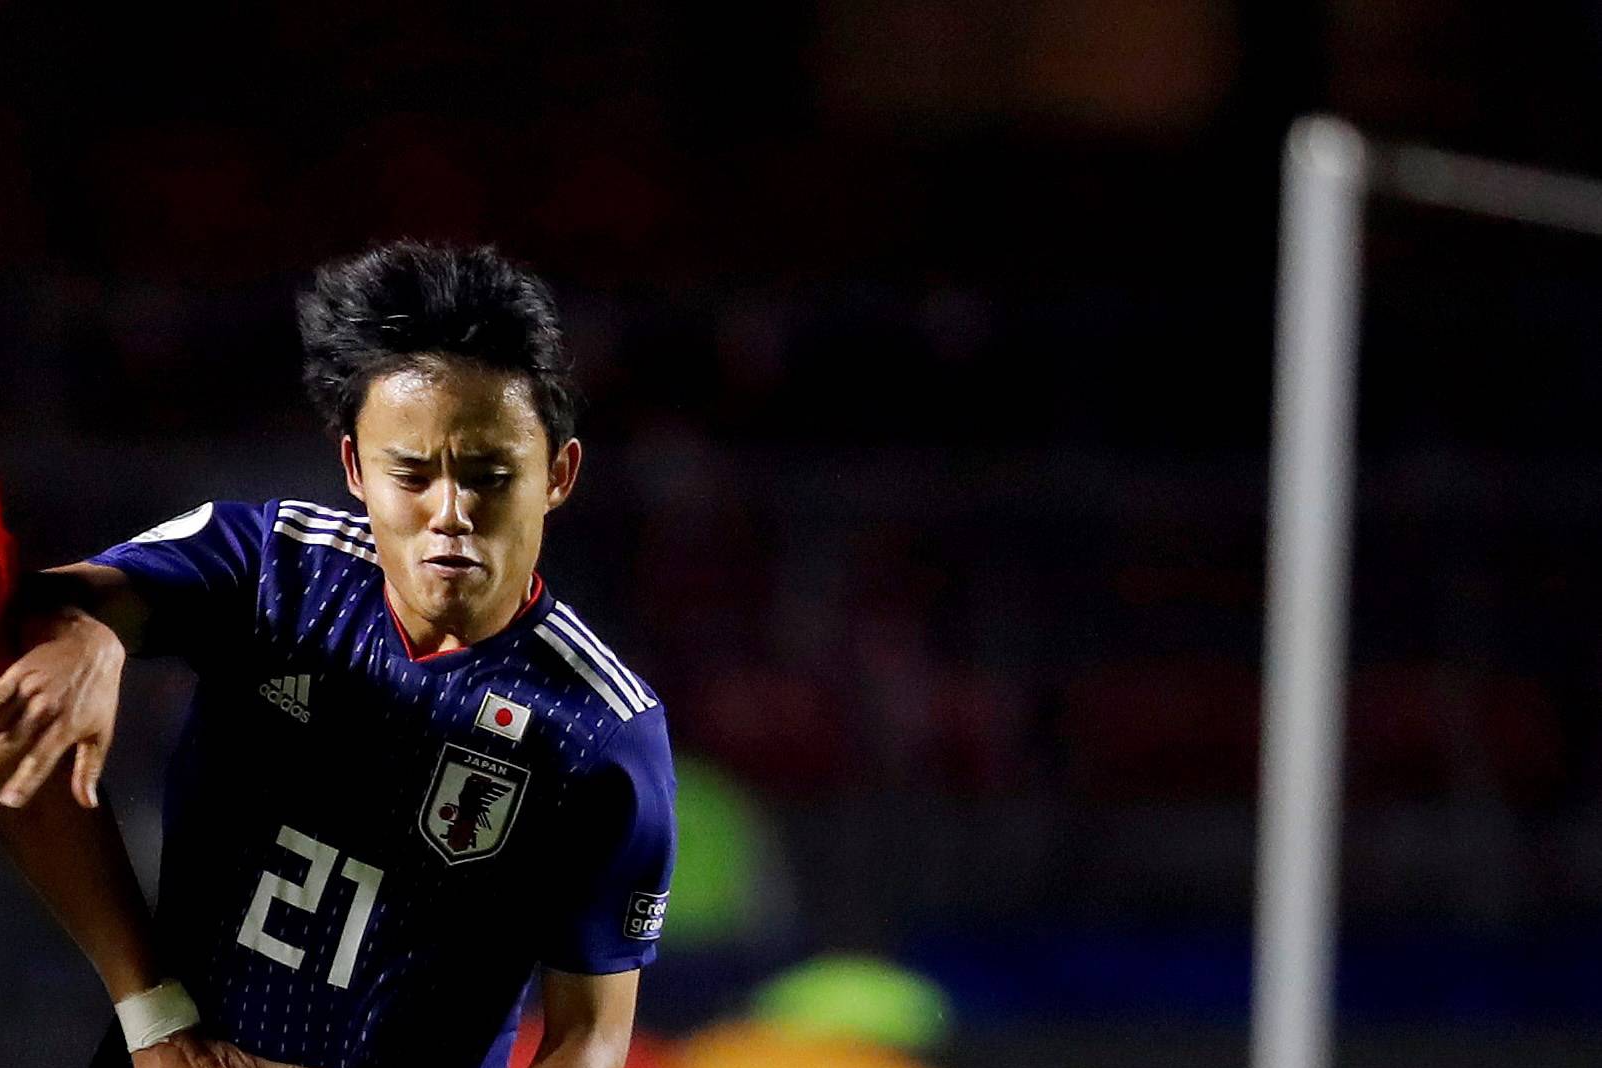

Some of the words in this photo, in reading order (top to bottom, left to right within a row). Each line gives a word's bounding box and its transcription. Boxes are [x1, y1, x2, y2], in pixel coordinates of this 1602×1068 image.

[259, 683, 310, 723] adidas
[464, 755, 507, 775] JAPAN
[237, 825, 384, 989] 21
